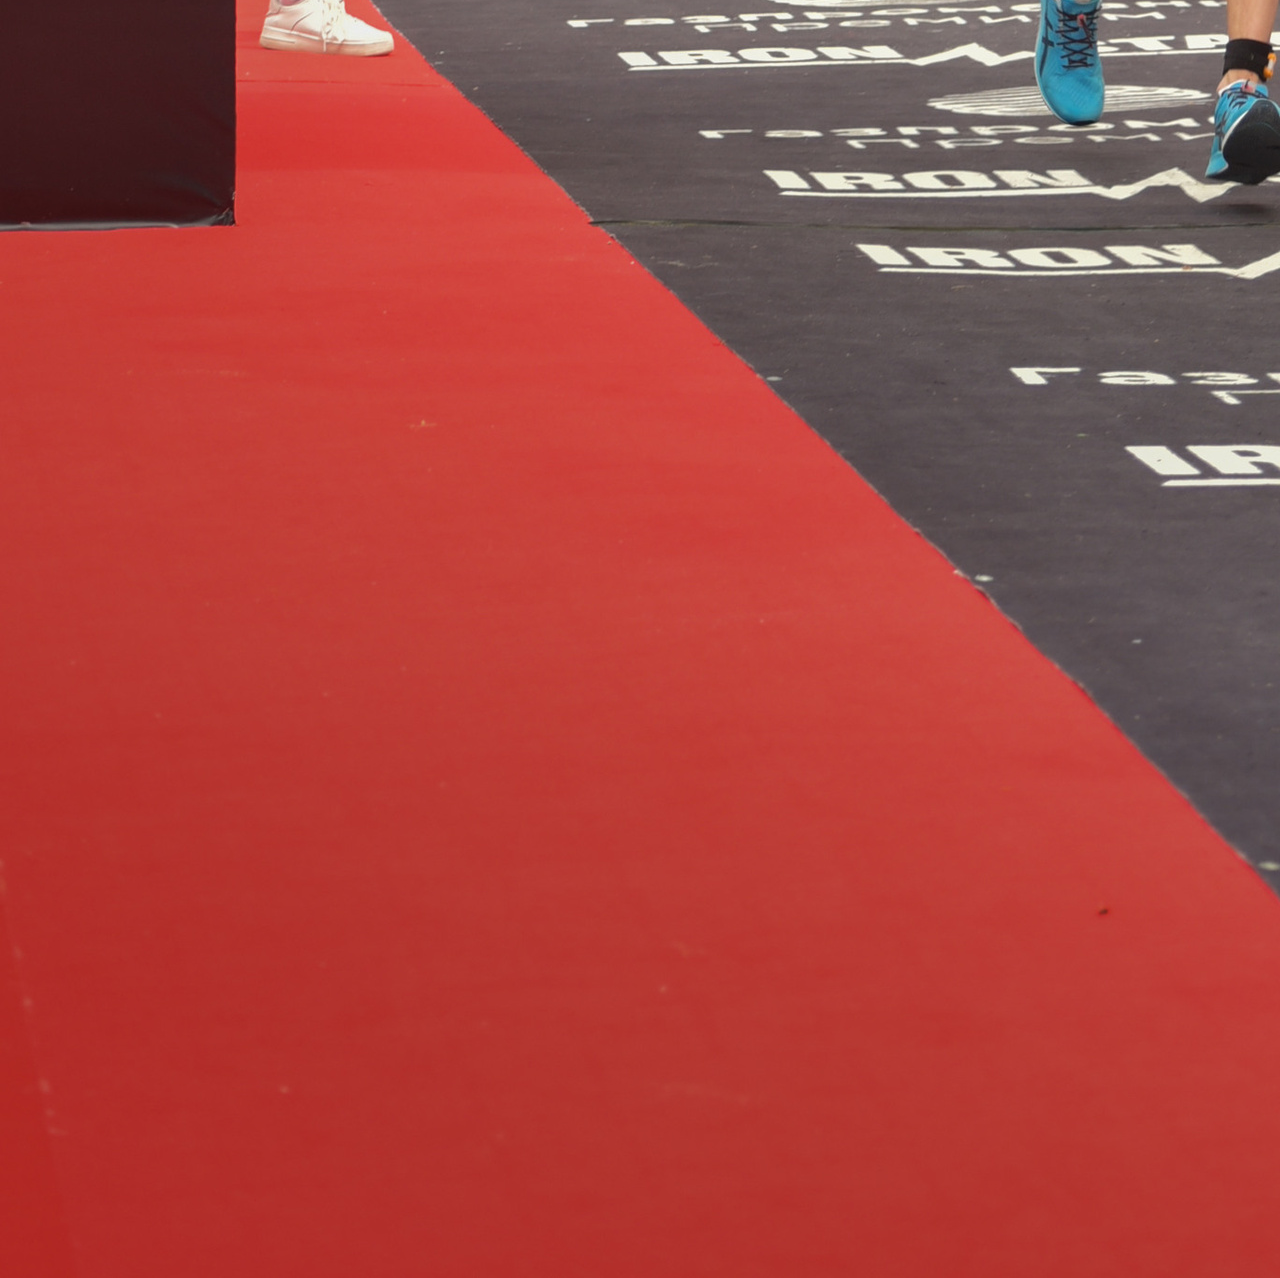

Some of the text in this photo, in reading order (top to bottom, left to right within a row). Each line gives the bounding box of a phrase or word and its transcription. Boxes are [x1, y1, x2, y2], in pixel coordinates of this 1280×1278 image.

[693, 11, 1166, 33] Премим
[616, 45, 905, 67] IRON
[761, 169, 1092, 190] IRON
[854, 243, 1221, 268] IRON
